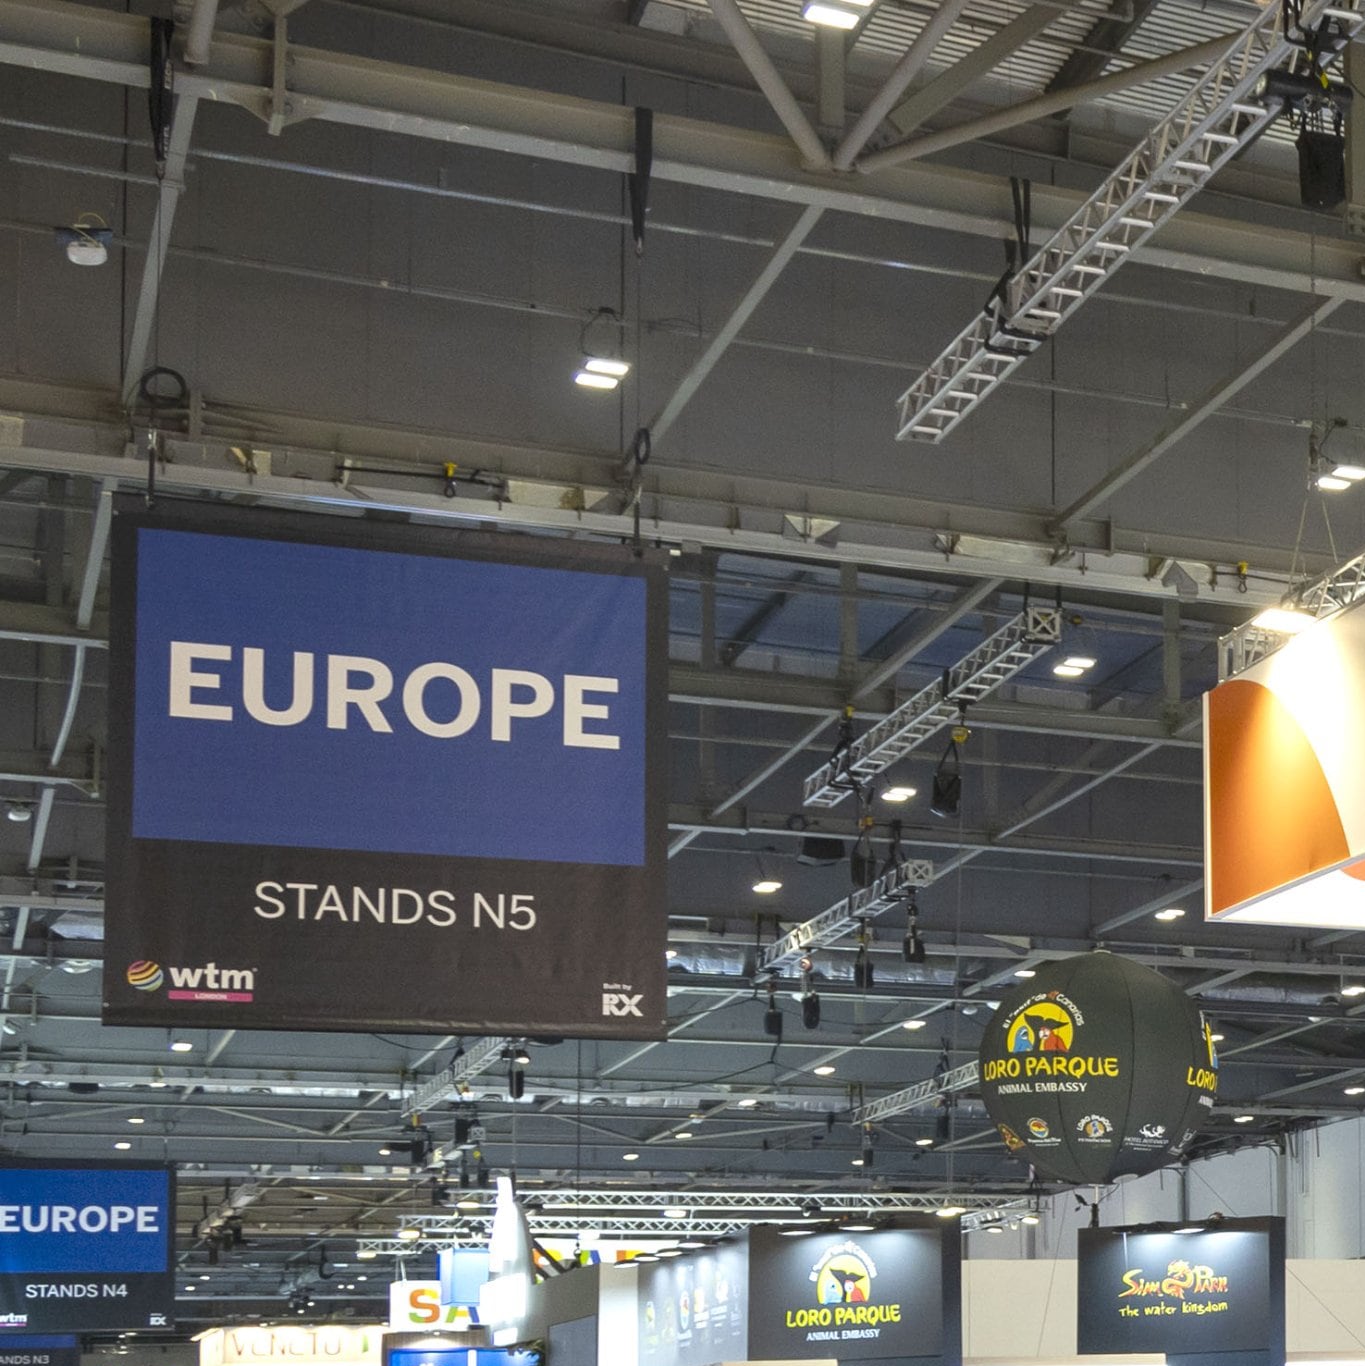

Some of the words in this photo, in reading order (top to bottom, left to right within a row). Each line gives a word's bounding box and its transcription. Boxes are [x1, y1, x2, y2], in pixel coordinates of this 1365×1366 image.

[168, 641, 621, 750] EUROPE
[253, 881, 457, 927] STANDS
[473, 892, 538, 932] N5
[168, 962, 254, 990] wtm
[602, 993, 644, 1017] RX
[984, 1057, 1021, 1081] LORO
[1025, 1056, 1119, 1079] PARQUE
[998, 1083, 1033, 1095] ANIMAL
[1035, 1082, 1088, 1093] EMBASSY
[0, 1205, 159, 1233] EUROPE
[25, 1284, 98, 1299] STANDS
[102, 1284, 128, 1298] N4
[786, 1308, 832, 1327] LORO
[835, 1304, 901, 1326] PARQUE
[1144, 1301, 1177, 1315] water
[1181, 1301, 1228, 1315] kingdom
[806, 1330, 840, 1341] ANIMAL
[841, 1328, 881, 1339] EMBASSY
